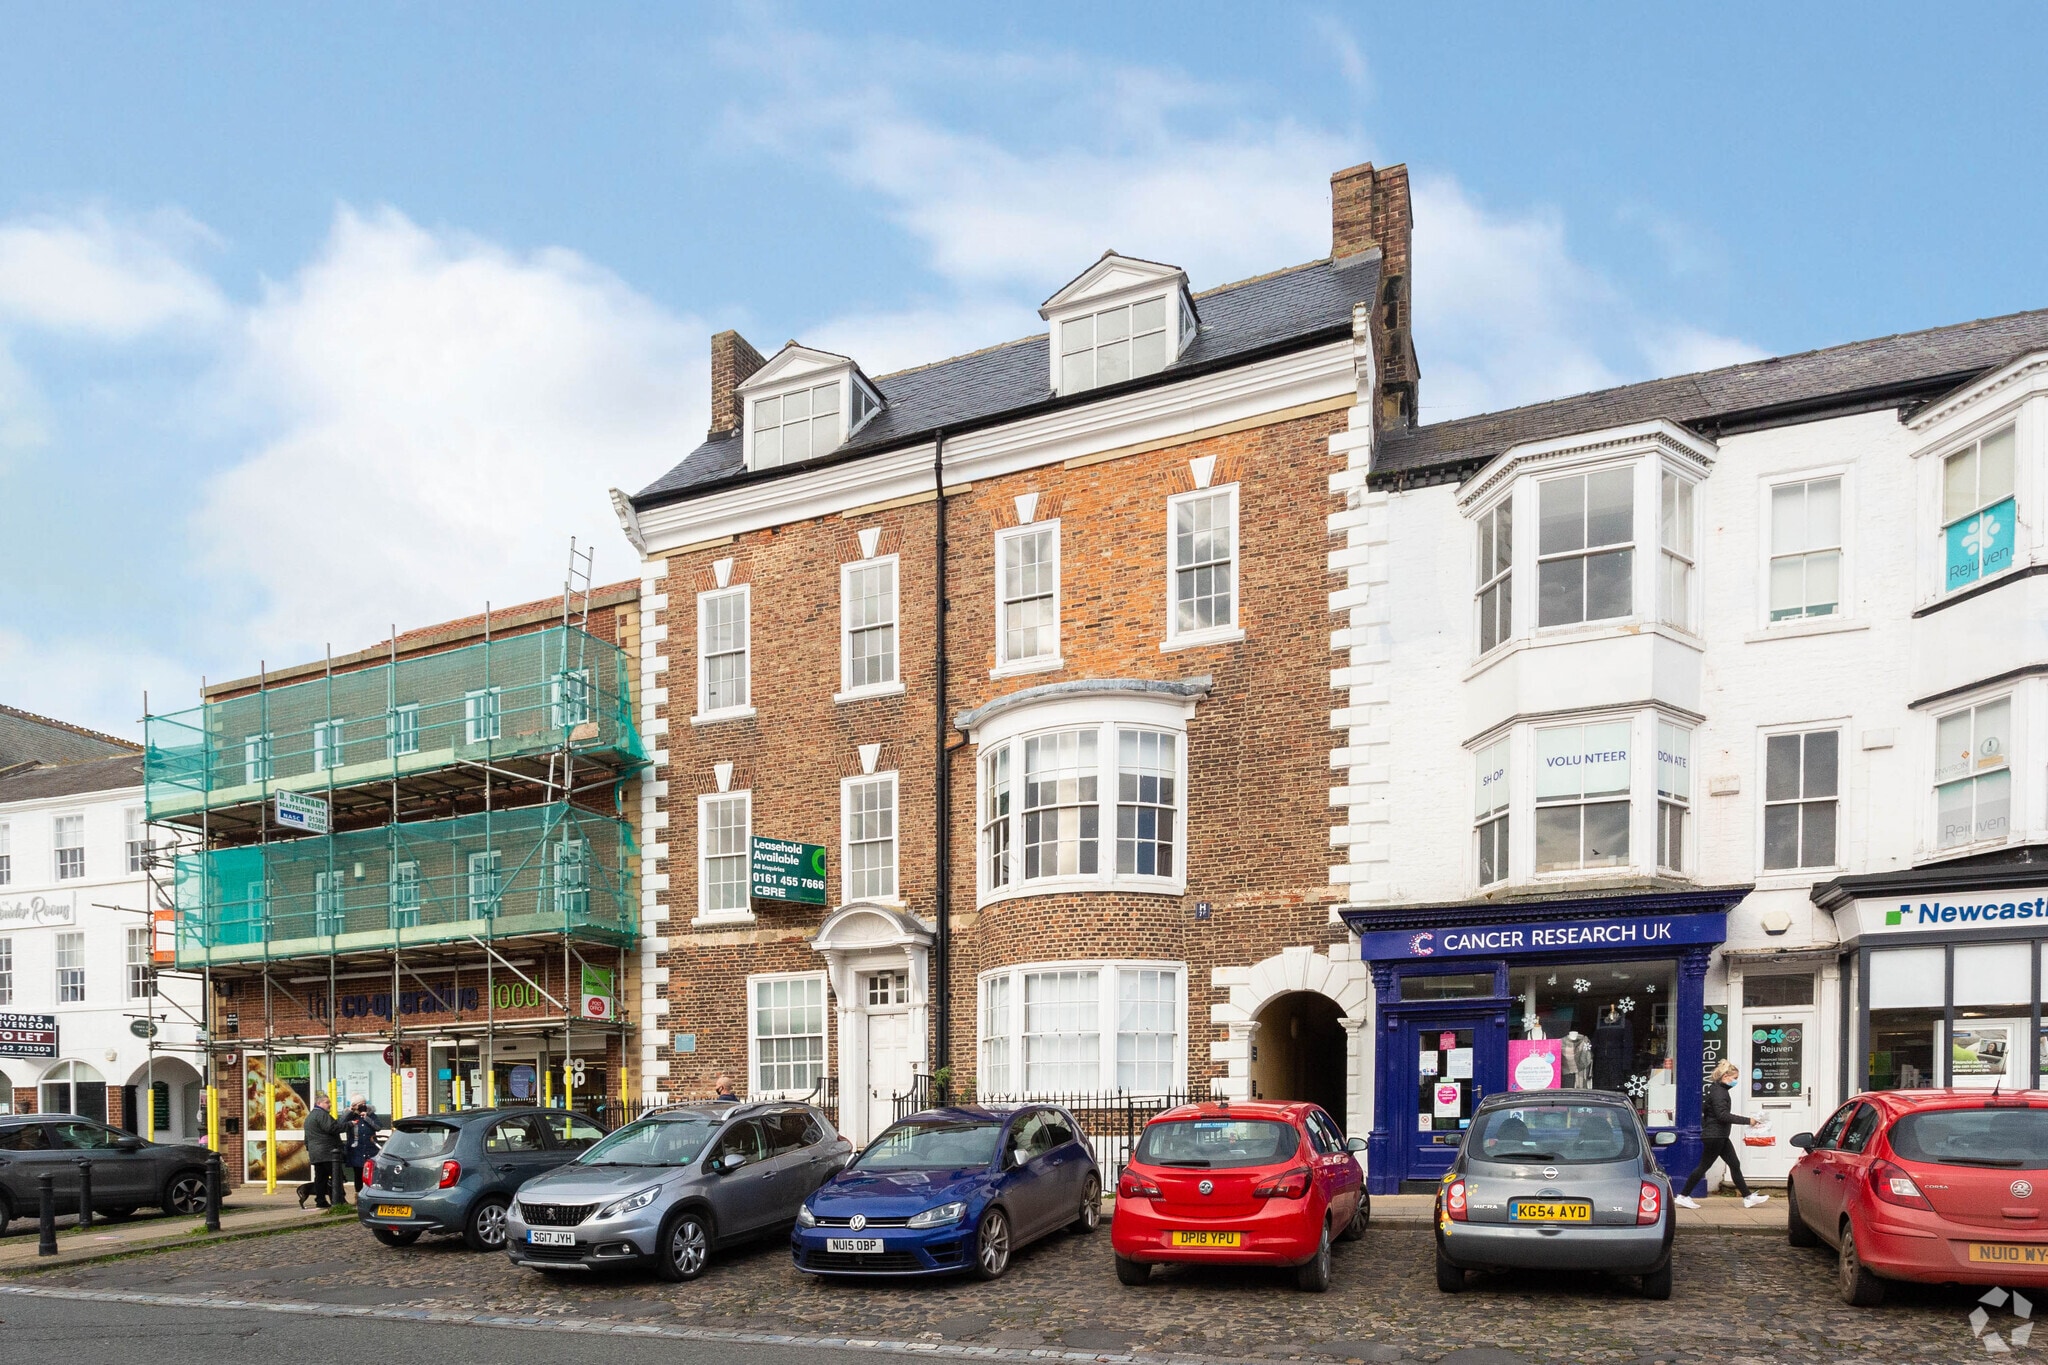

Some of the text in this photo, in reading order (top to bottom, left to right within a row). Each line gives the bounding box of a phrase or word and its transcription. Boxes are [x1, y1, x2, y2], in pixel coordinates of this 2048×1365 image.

[1950, 547, 2009, 581] Rejuven
[1546, 750, 1627, 768] VOLUNTEER
[1657, 750, 1687, 768] DONATE
[1482, 768, 1504, 786] SHOP
[278, 801, 314, 815] SCAFFOLDING
[289, 794, 326, 810] STEWART
[282, 812, 302, 821] NASC
[1945, 816, 2007, 840] Rejuven
[753, 838, 803, 854] Leasehold
[753, 850, 800, 866] Available
[761, 864, 785, 873] Enquiries
[752, 872, 825, 890] 0161 455 7666
[754, 885, 786, 898] CBRE
[1443, 931, 1524, 951] CANCER
[1531, 924, 1637, 947] RESEARCH
[1642, 922, 1672, 940] UK
[491, 973, 540, 1010] food
[0, 1020, 53, 1030] VENSON
[0, 1031, 44, 1042] O LET
[17, 1045, 51, 1053] 713303
[1760, 1045, 1794, 1055] Rejuven
[1518, 1205, 1555, 1218] KG54
[1559, 1206, 1587, 1218] AYD
[533, 1232, 572, 1244] SG17 JYH
[832, 1239, 877, 1251] NU15 OBP
[1181, 1232, 1235, 1244] DP18 YPU
[1979, 1245, 2048, 1263] NU10 WY
